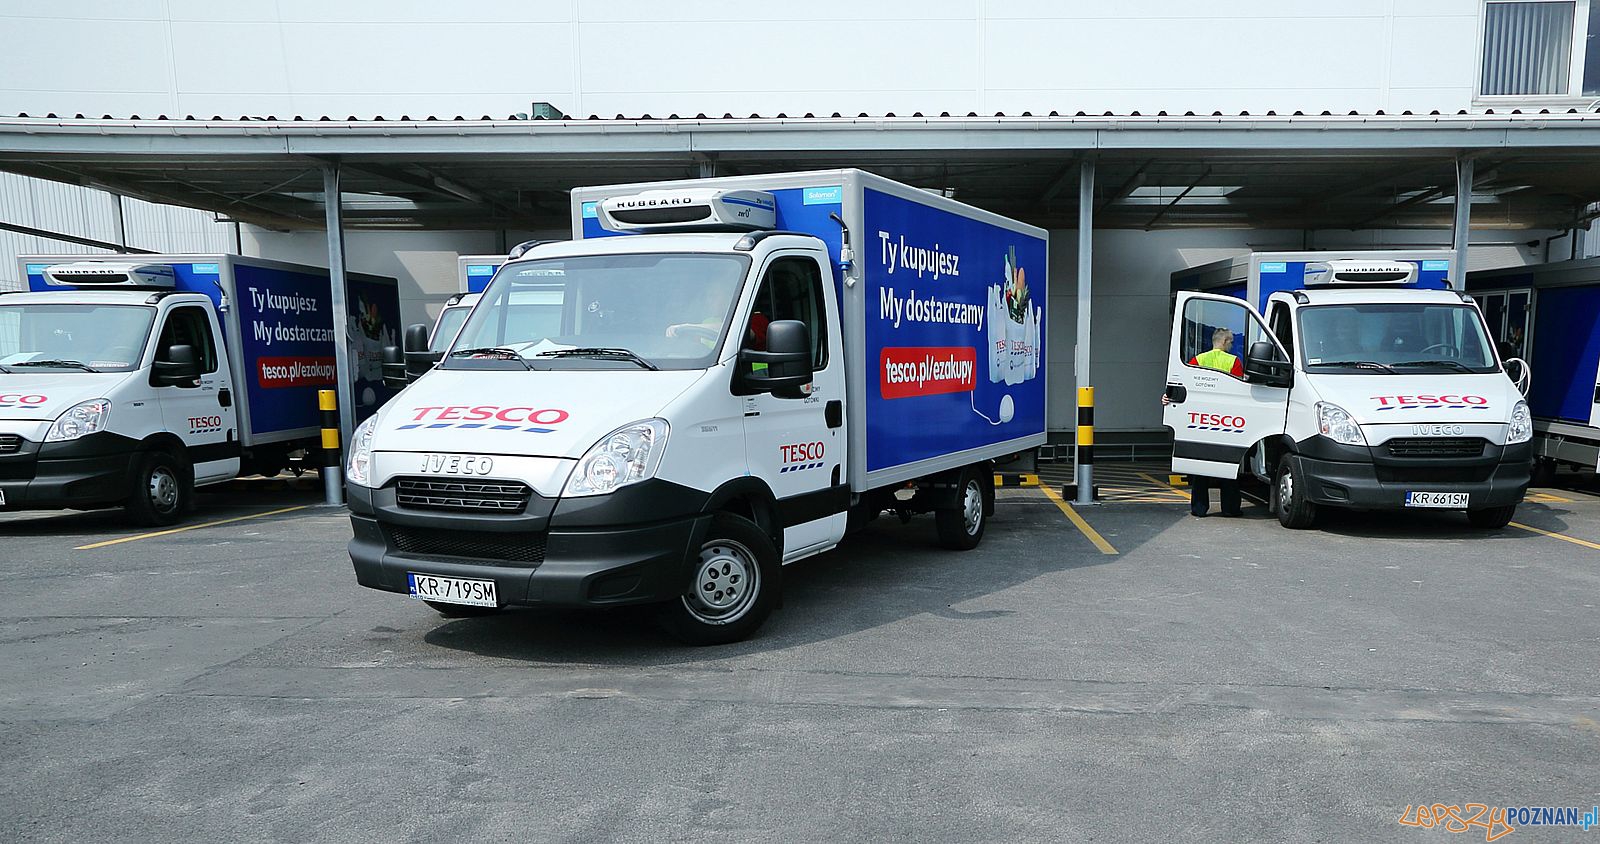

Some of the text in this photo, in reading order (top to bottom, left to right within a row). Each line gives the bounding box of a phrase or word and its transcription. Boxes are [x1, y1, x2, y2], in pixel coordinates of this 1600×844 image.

[616, 197, 692, 209] HUBBARD
[879, 231, 959, 280] Ty kupujesz
[249, 287, 317, 317] Ty kupujesz
[880, 287, 984, 331] My dostarczamy
[253, 320, 335, 346] My dostarczam
[262, 361, 335, 382] tesco.pl/ezakupy
[886, 354, 973, 388] tesco.pl/ezakupy
[1369, 395, 1488, 405] TESCO
[188, 416, 221, 428] TESCO
[412, 405, 569, 425] TESCO
[1187, 412, 1246, 427] TESCO
[1411, 425, 1465, 435] IVECO
[780, 441, 825, 463] TESCO
[420, 455, 494, 475] IVECO
[1412, 493, 1468, 505] KR 661SM
[416, 576, 495, 601] KR 719SM
